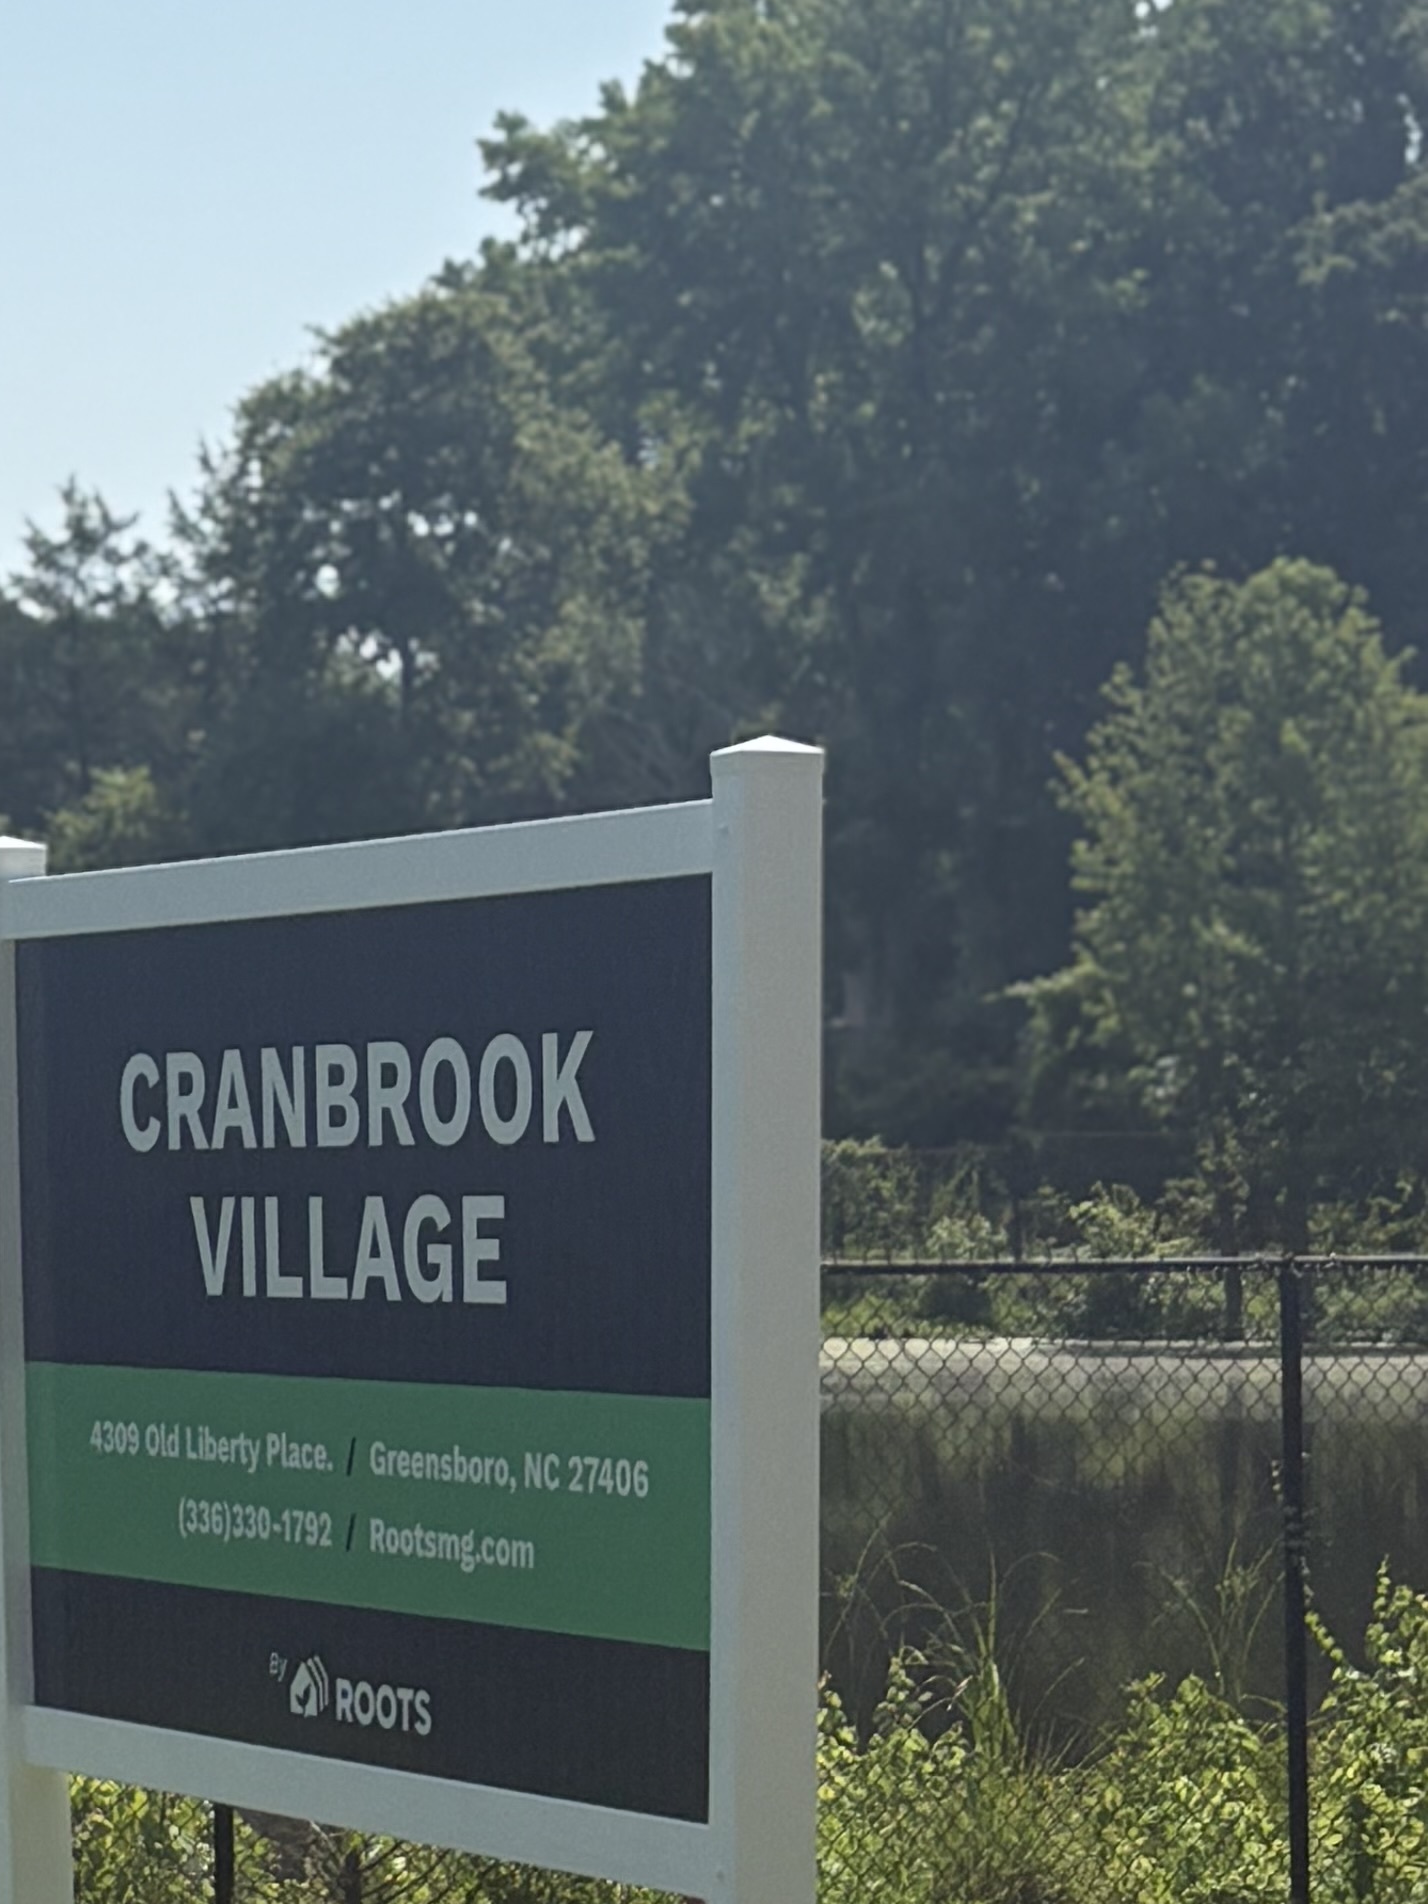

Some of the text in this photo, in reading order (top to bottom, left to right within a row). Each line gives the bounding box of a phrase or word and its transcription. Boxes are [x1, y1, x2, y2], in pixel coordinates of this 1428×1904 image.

[119, 1030, 596, 1153] CRANBROOK
[189, 1193, 508, 1304] VILLAGE
[89, 1419, 141, 1456] 4309
[144, 1422, 180, 1459] Old
[185, 1426, 261, 1474] Liberty
[265, 1432, 334, 1472] Place.
[369, 1440, 518, 1494] Greensboro,
[523, 1451, 561, 1491] NC
[567, 1455, 650, 1498] 27406
[178, 1496, 333, 1547] (336)330-1792
[369, 1517, 536, 1573] Rootsmg.com
[269, 1651, 432, 1736] By ROOTS
